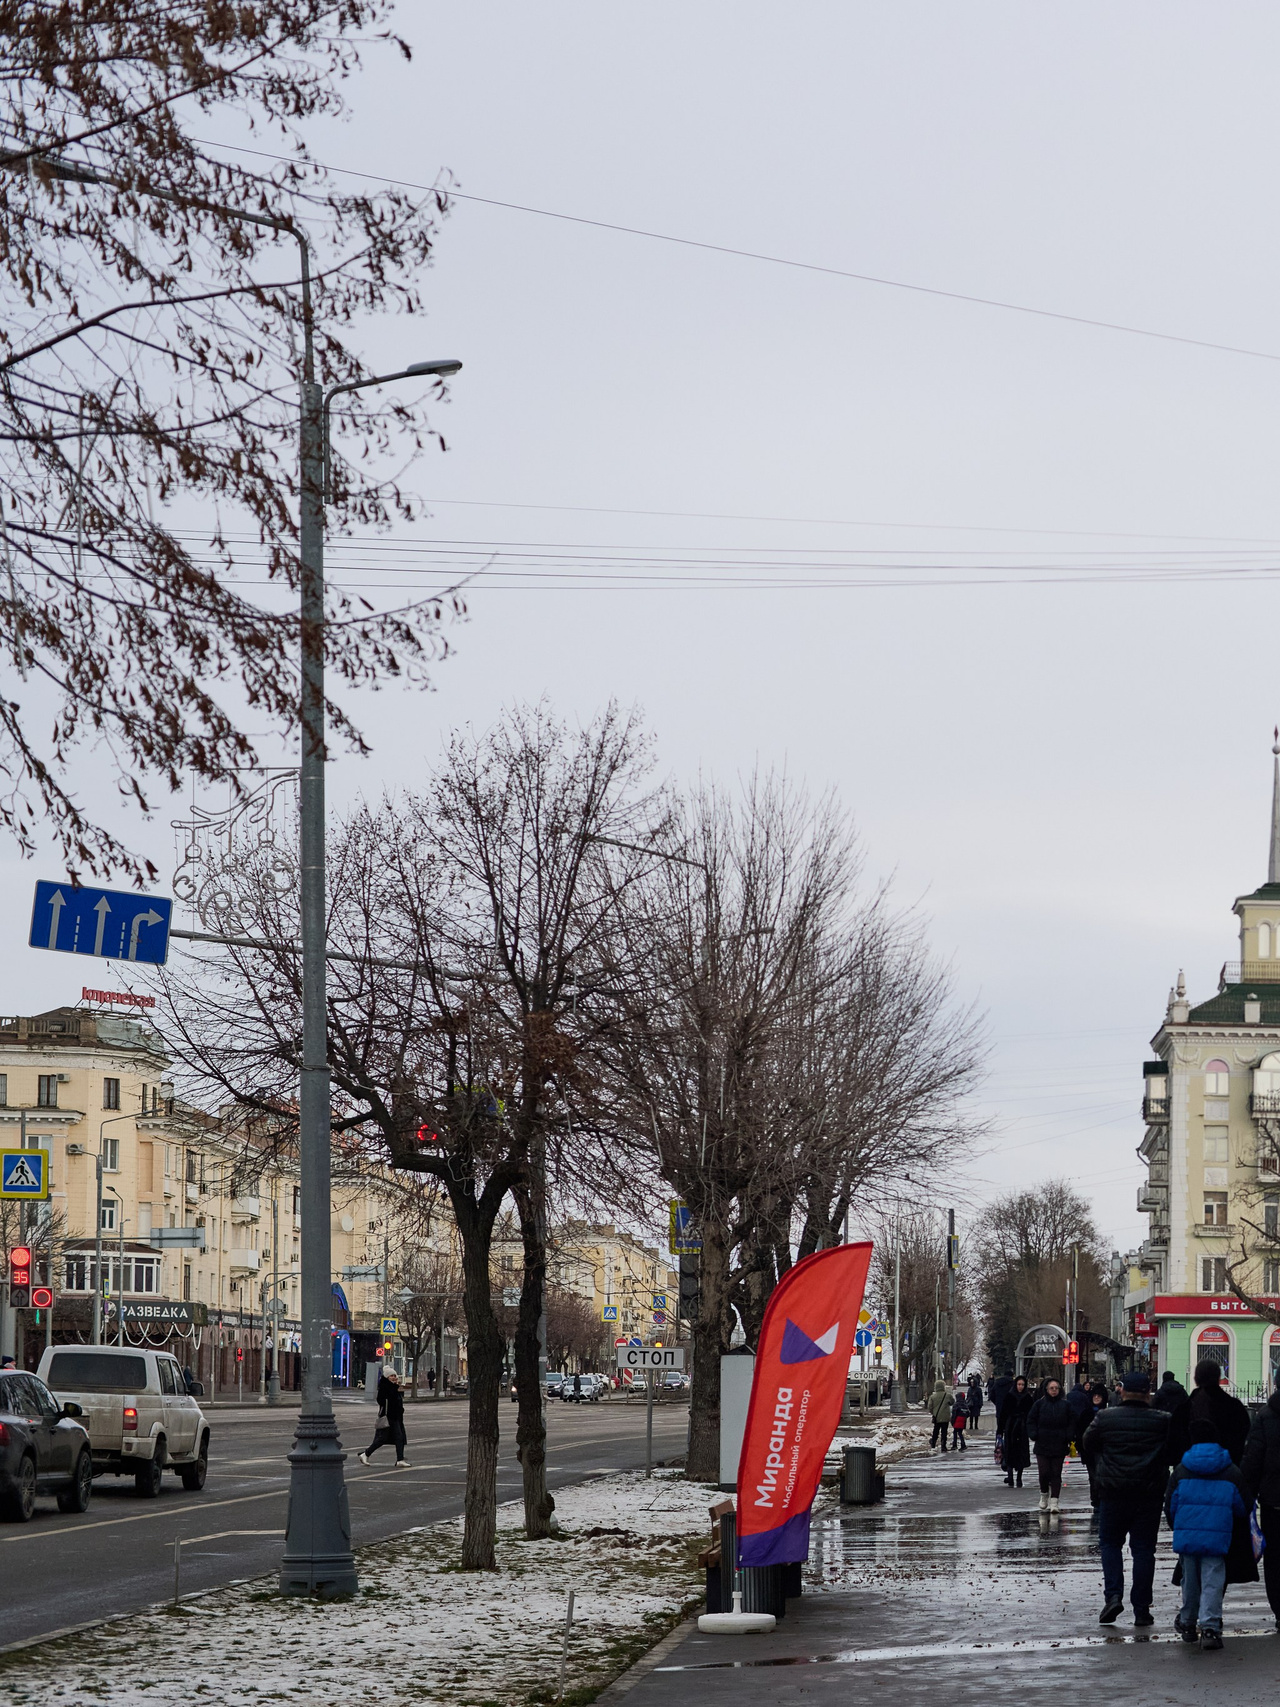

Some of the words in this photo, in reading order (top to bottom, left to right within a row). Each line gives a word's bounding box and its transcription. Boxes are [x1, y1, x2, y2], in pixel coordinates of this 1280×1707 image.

[13, 1271, 29, 1284] 35
[1210, 1301, 1277, 1311] БЫТОЯ
[627, 1350, 675, 1366] СТОП
[754, 1387, 794, 1508] Миранда
[782, 1444, 800, 1509] Мобильный
[794, 1389, 811, 1443] оператор
